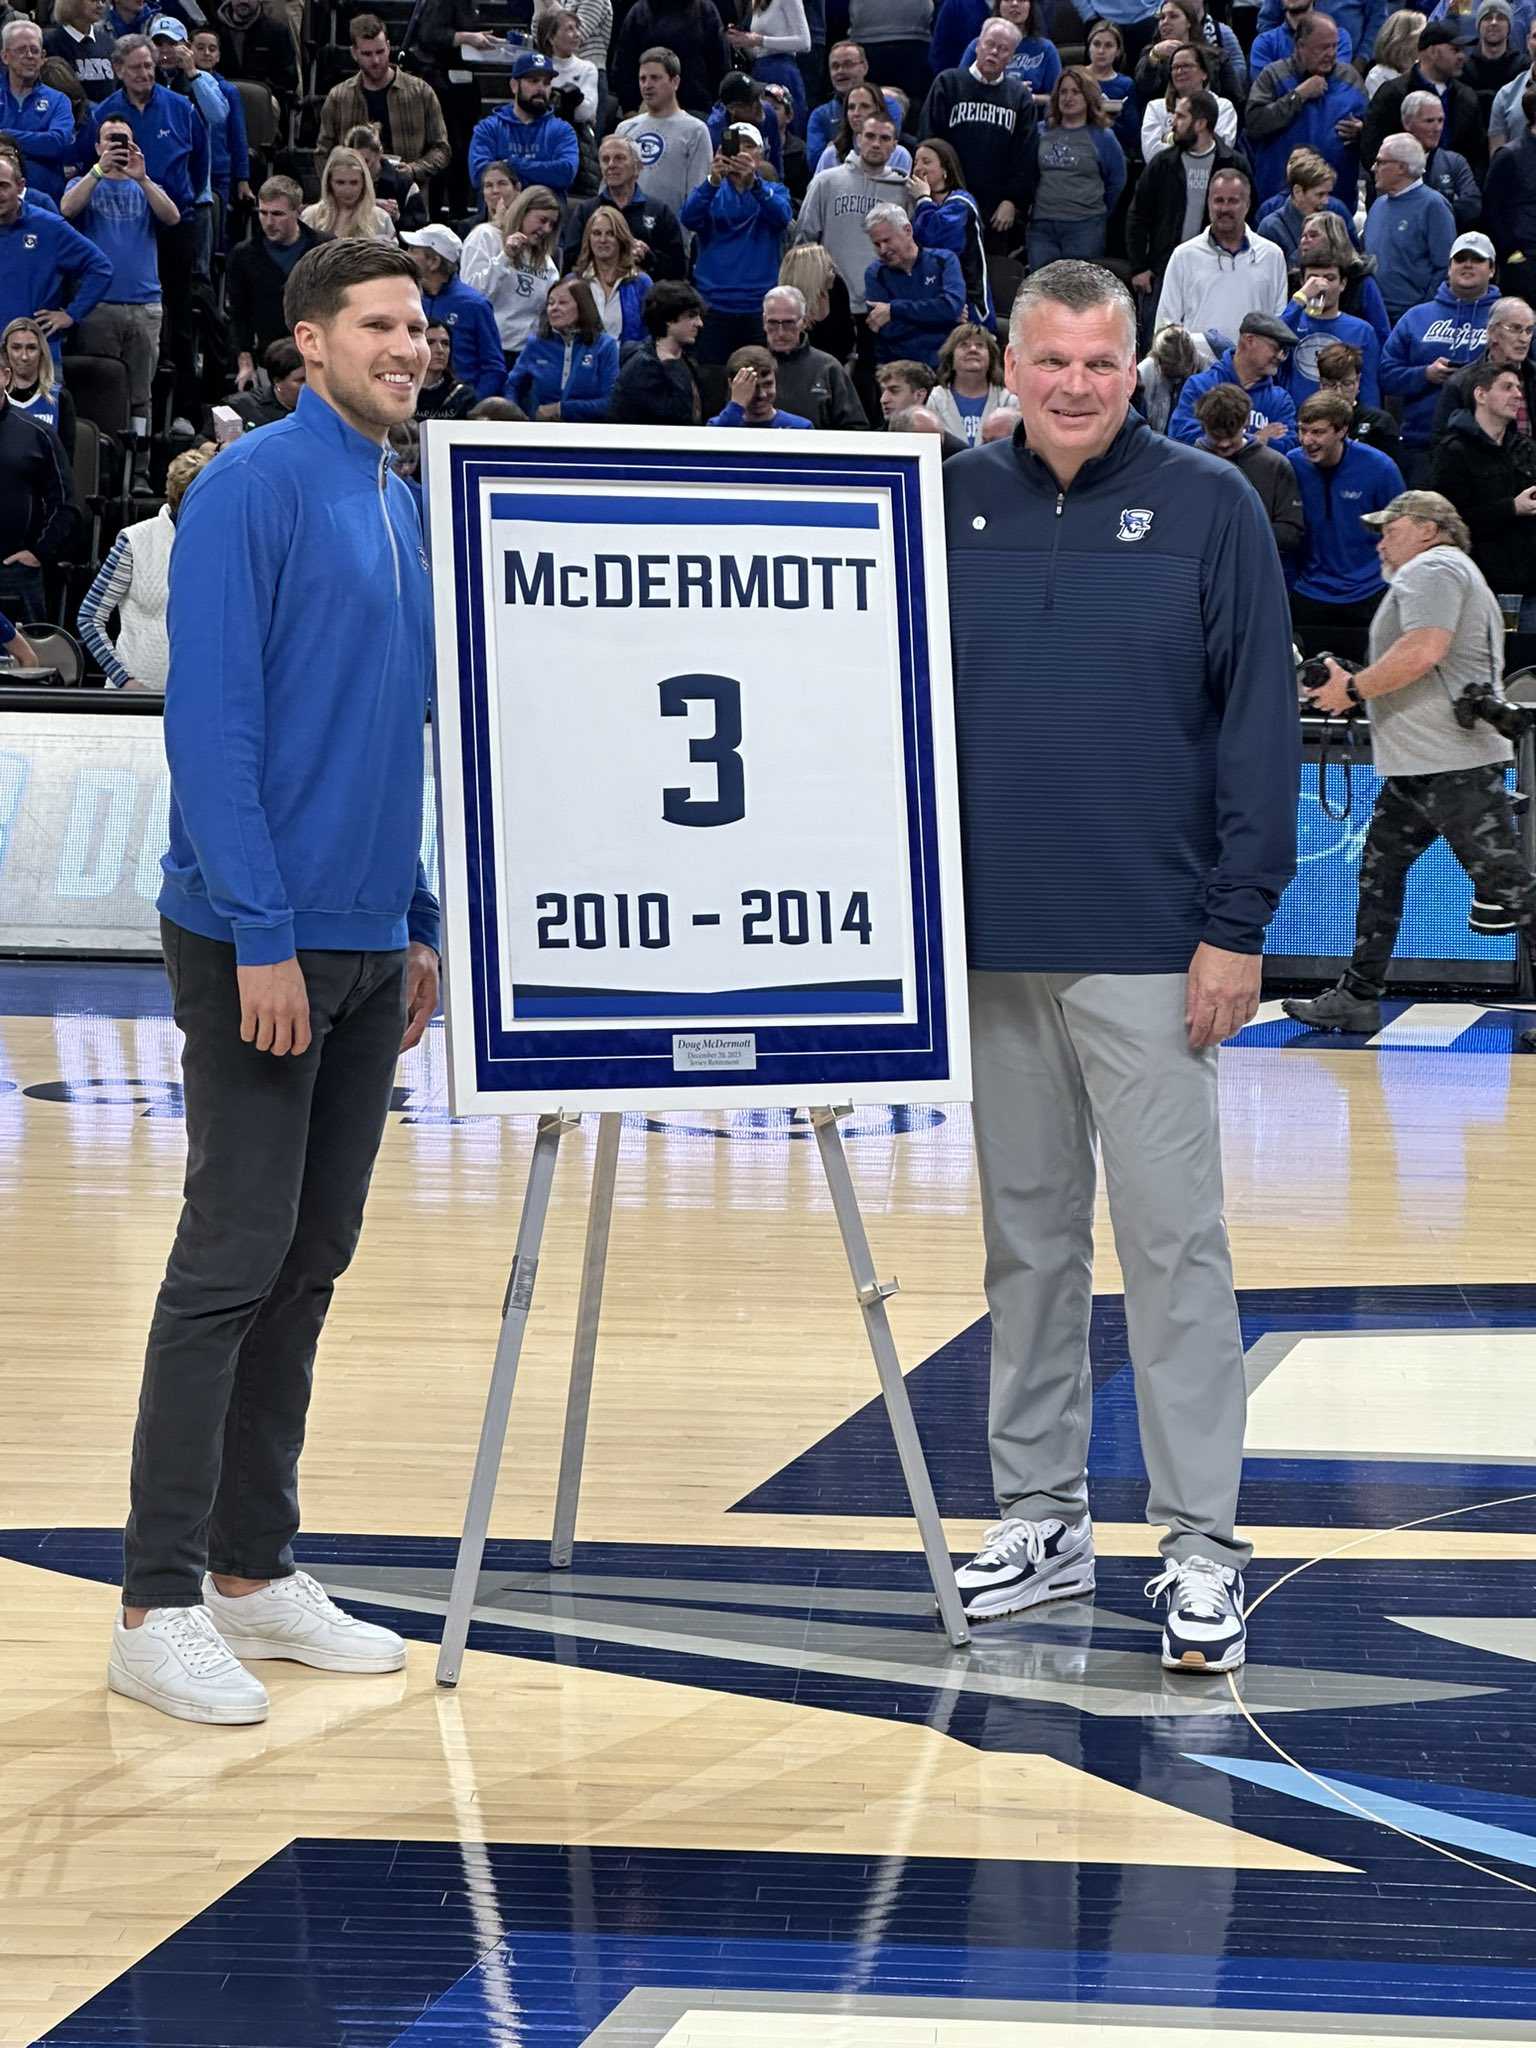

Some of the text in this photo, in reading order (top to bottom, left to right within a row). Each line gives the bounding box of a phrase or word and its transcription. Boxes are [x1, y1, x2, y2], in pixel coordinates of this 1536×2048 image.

[75, 58, 114, 80] JAYS
[834, 194, 884, 217] CREIGH
[503, 550, 877, 611] McDERMOTT
[656, 673, 746, 828] 3
[536, 889, 873, 950] 2010 - 2014
[678, 1039, 751, 1051] Doug McDermott
